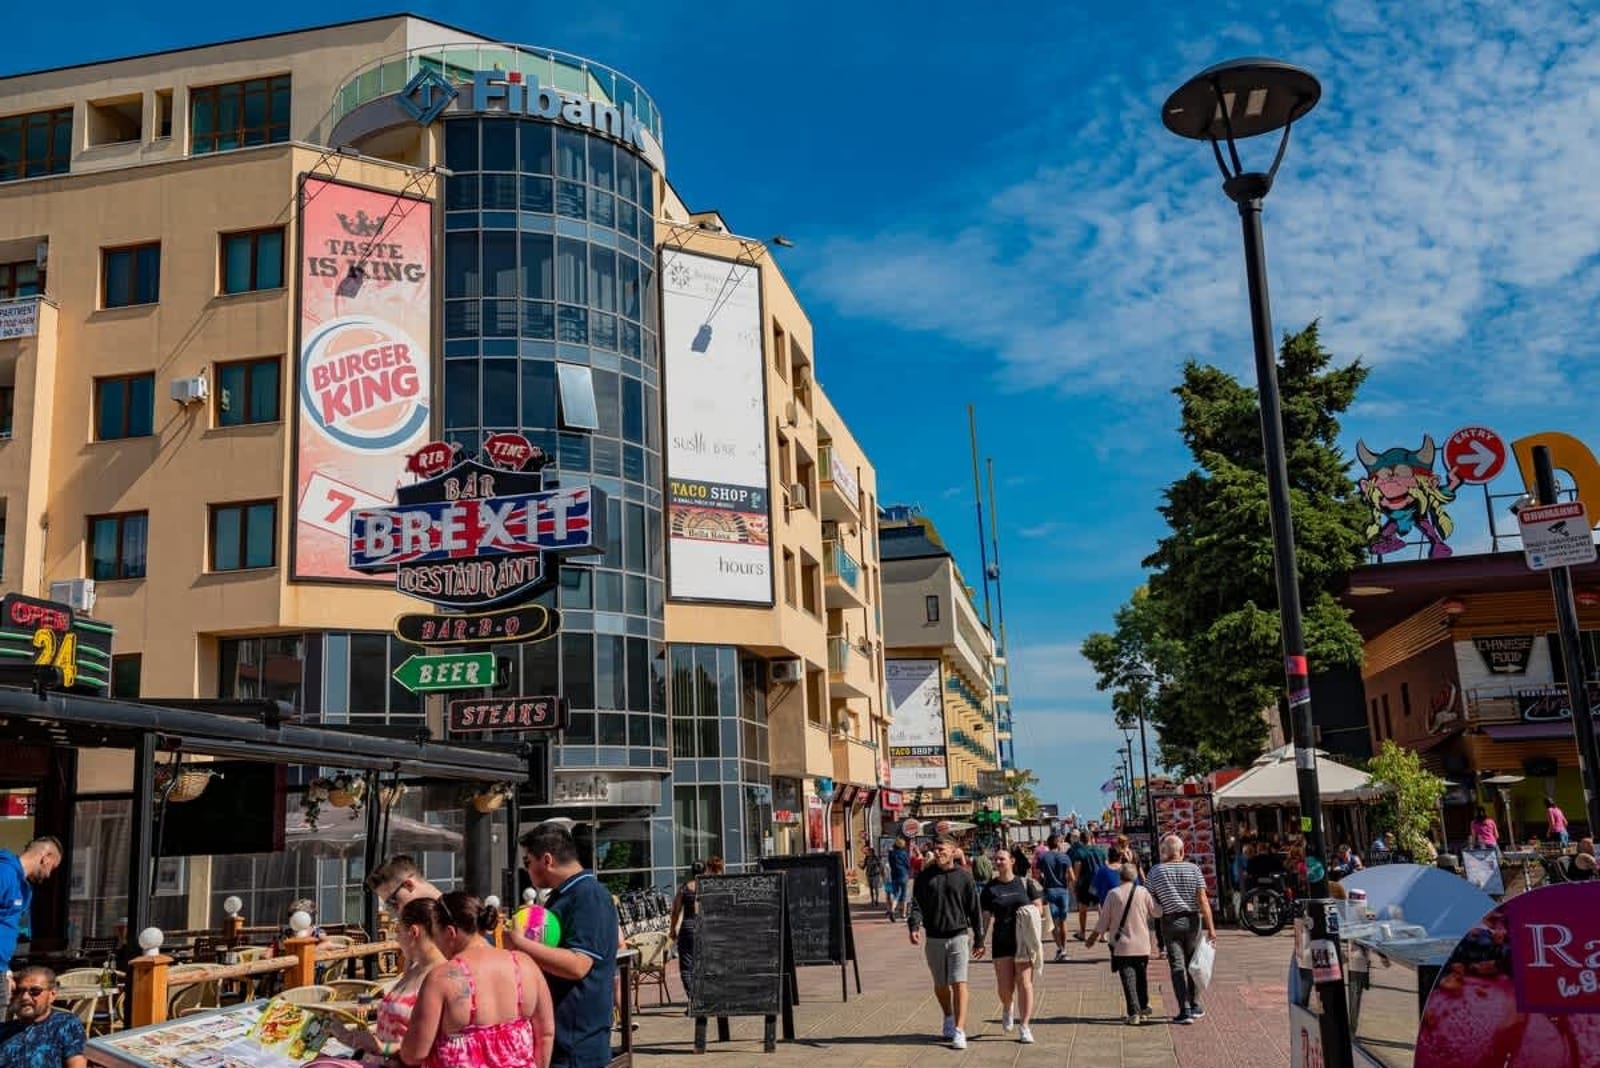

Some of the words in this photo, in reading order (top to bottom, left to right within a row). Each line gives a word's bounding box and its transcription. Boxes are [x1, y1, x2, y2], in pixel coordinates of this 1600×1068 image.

[474, 70, 648, 151] Fibank
[325, 239, 403, 259] TASTE
[308, 257, 338, 277] IS
[347, 259, 425, 282] KING
[312, 344, 411, 391] BURGER
[321, 365, 419, 425] KING
[1454, 429, 1494, 444] ENTRY
[420, 452, 445, 468] RIB
[493, 440, 526, 459] TIME
[443, 473, 496, 500] BAR
[671, 482, 706, 498] TACO
[711, 487, 748, 502] SHOP
[325, 489, 355, 523] 7
[364, 498, 576, 558] BREXIT
[400, 557, 539, 598] RESTAURANT
[719, 555, 764, 576] hours
[10, 600, 69, 630] OPEN
[33, 626, 77, 687] 24
[1477, 639, 1531, 650] CHINESE
[1491, 652, 1522, 663] FOOD
[419, 661, 480, 684] BEER
[1521, 689, 1569, 698] RESTAURAN
[461, 702, 547, 726] STEAKS
